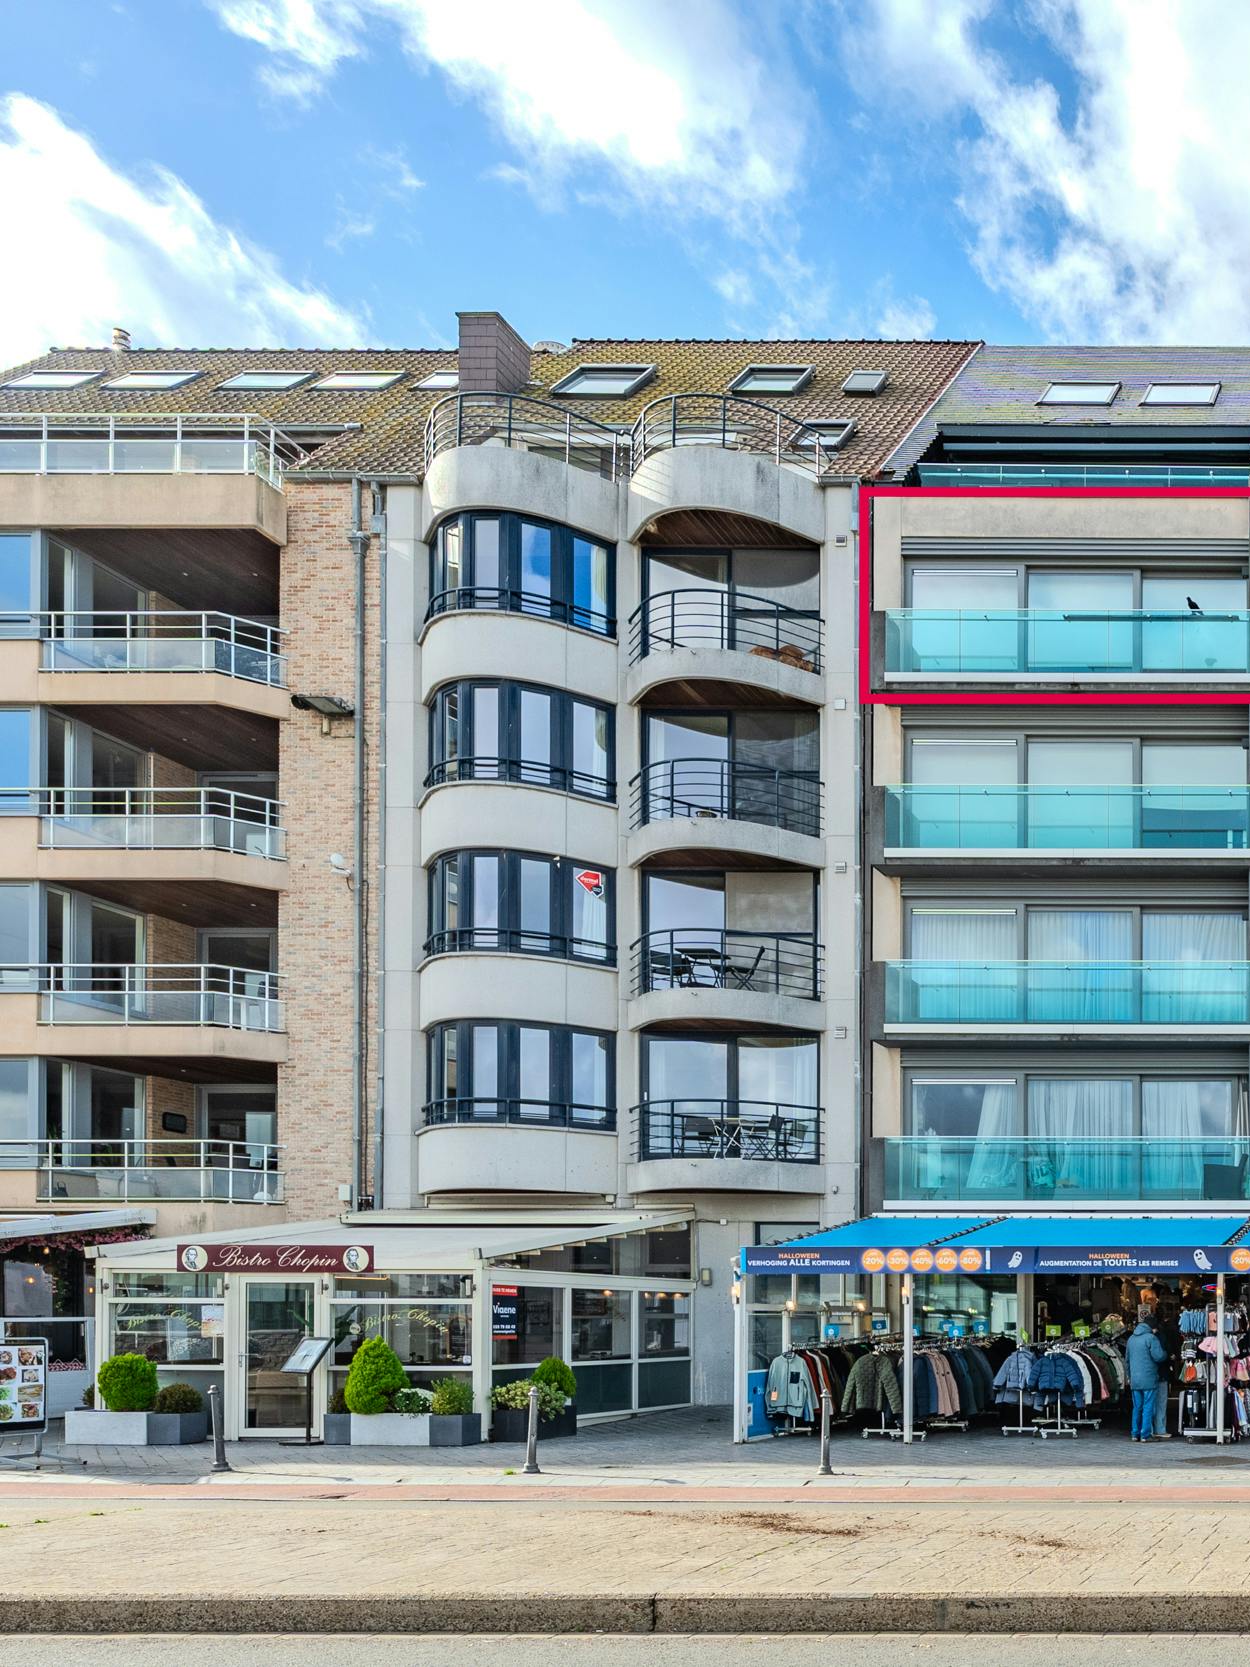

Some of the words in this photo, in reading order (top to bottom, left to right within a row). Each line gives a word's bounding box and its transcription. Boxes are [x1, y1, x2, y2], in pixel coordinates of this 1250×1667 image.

[213, 1246, 272, 1266] Bistro
[276, 1246, 338, 1272] Chopin
[408, 1308, 449, 1334] Chopin
[493, 1302, 516, 1314] Viaene
